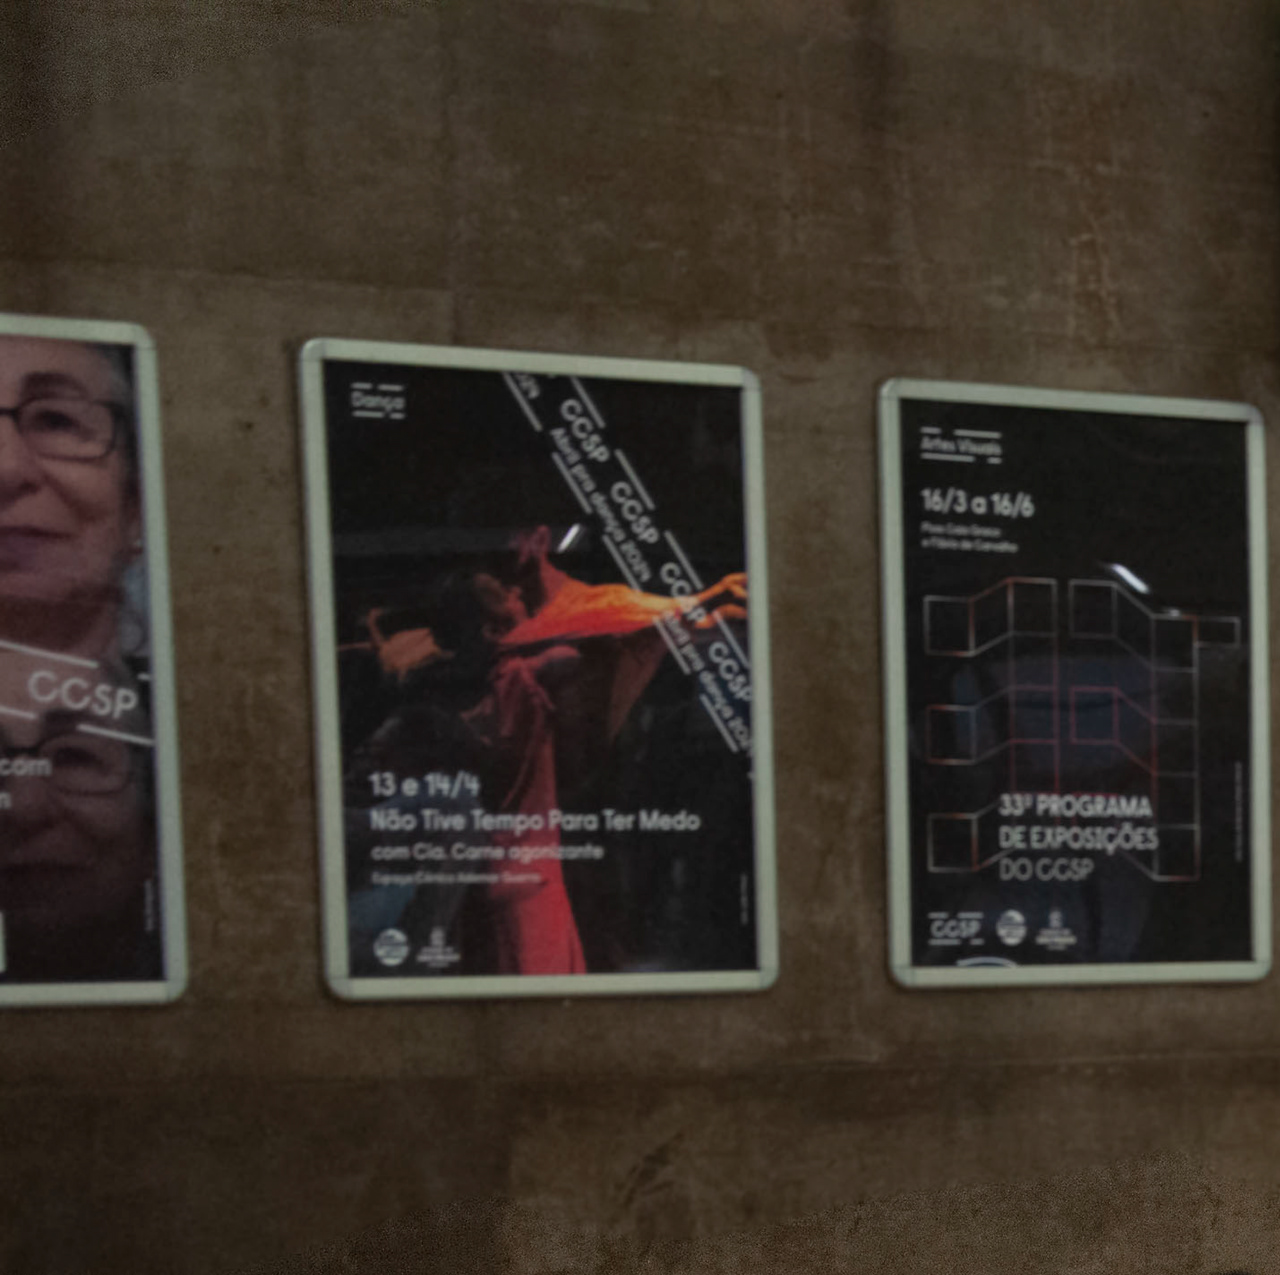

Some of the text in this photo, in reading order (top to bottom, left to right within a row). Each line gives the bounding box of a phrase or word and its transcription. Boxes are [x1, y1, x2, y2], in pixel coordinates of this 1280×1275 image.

[560, 399, 610, 463] CCSP
[610, 481, 660, 544] CCSP
[920, 486, 1035, 519] 16/3 a 16/6
[28, 671, 138, 718] CCSP
[368, 770, 480, 799] 13 e 14/4
[1035, 793, 1153, 818] PROGRAMA
[369, 808, 700, 837] Não Tive Tempo Para Ter Medo
[370, 842, 604, 865] com Cia. Carne agonizante
[999, 821, 1160, 857] DE EXPOSIÇÕES
[999, 857, 1095, 882] DO CCSP
[929, 918, 982, 939] CCSP
